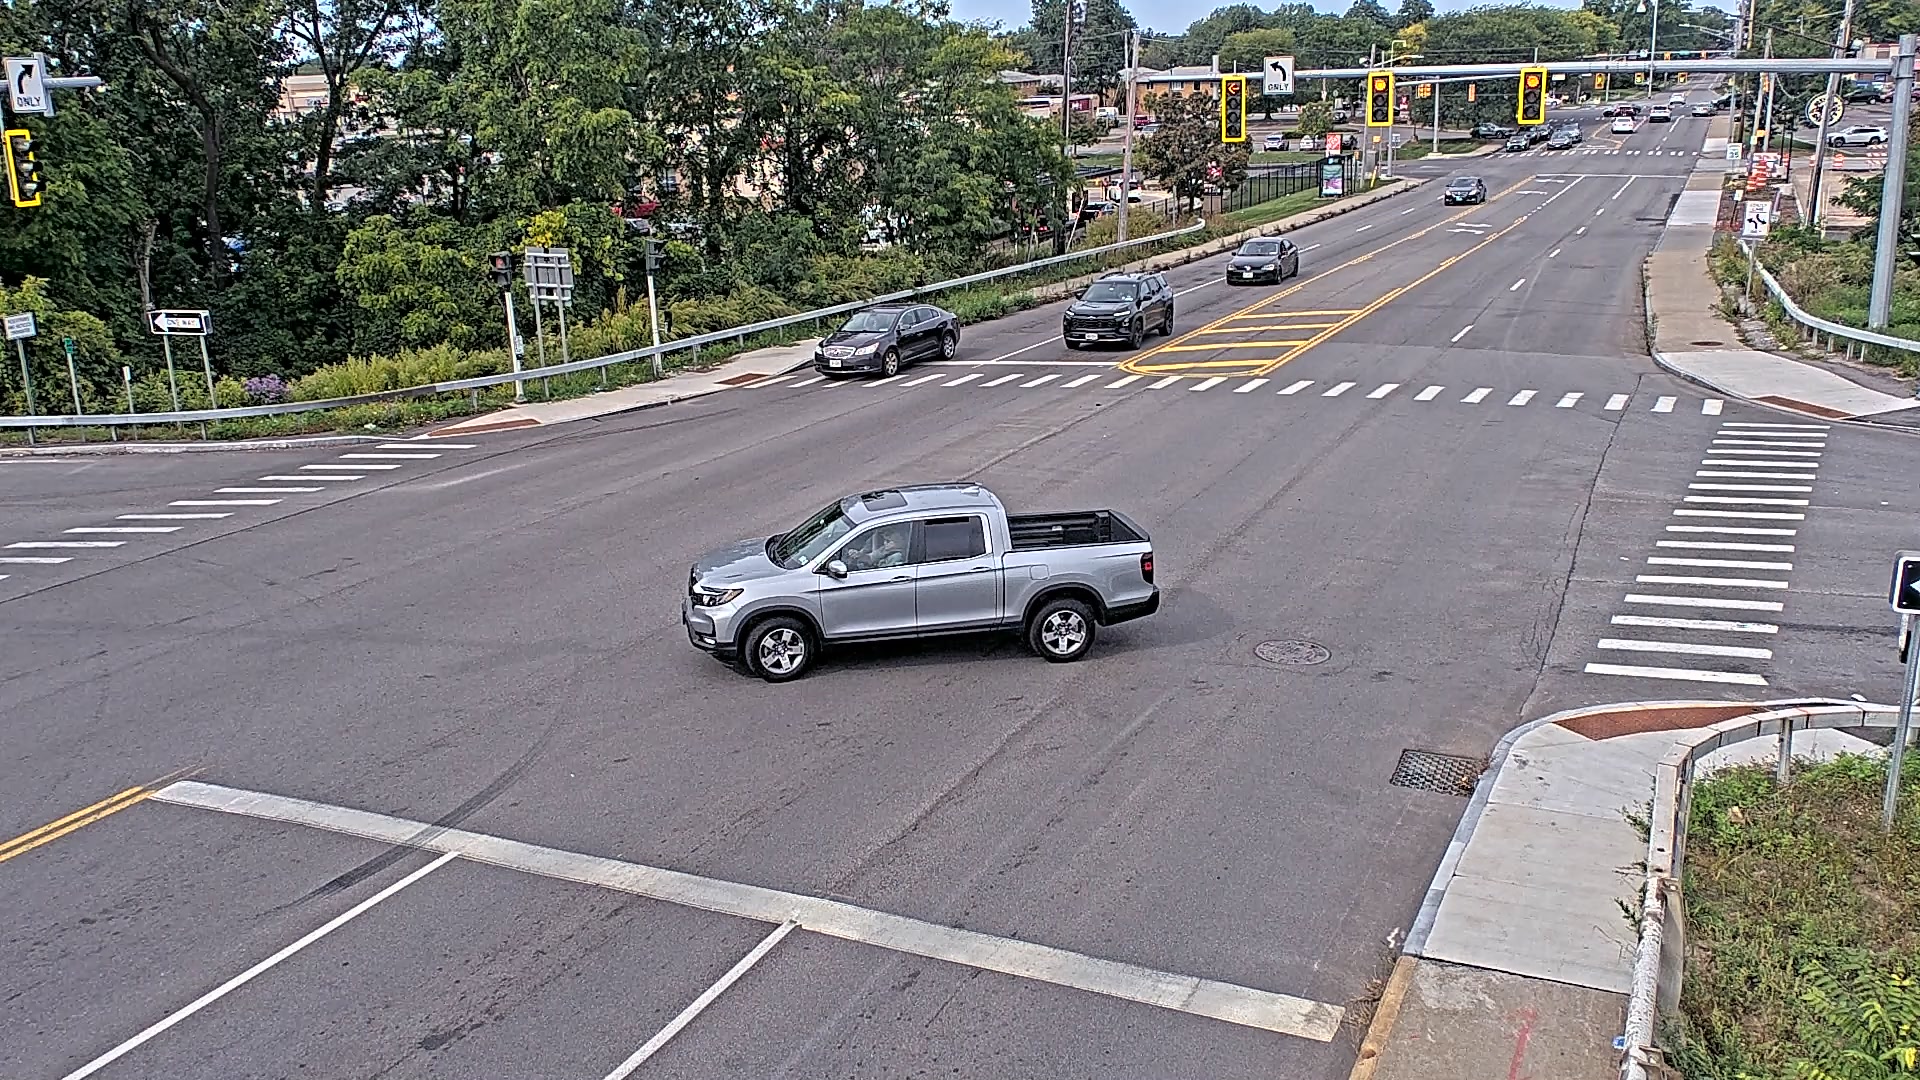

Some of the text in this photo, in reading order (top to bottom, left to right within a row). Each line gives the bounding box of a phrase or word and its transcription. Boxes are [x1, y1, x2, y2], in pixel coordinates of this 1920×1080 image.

[1267, 83, 1290, 92] ONLY
[16, 96, 41, 107] ONLY
[166, 318, 180, 327] ONE
